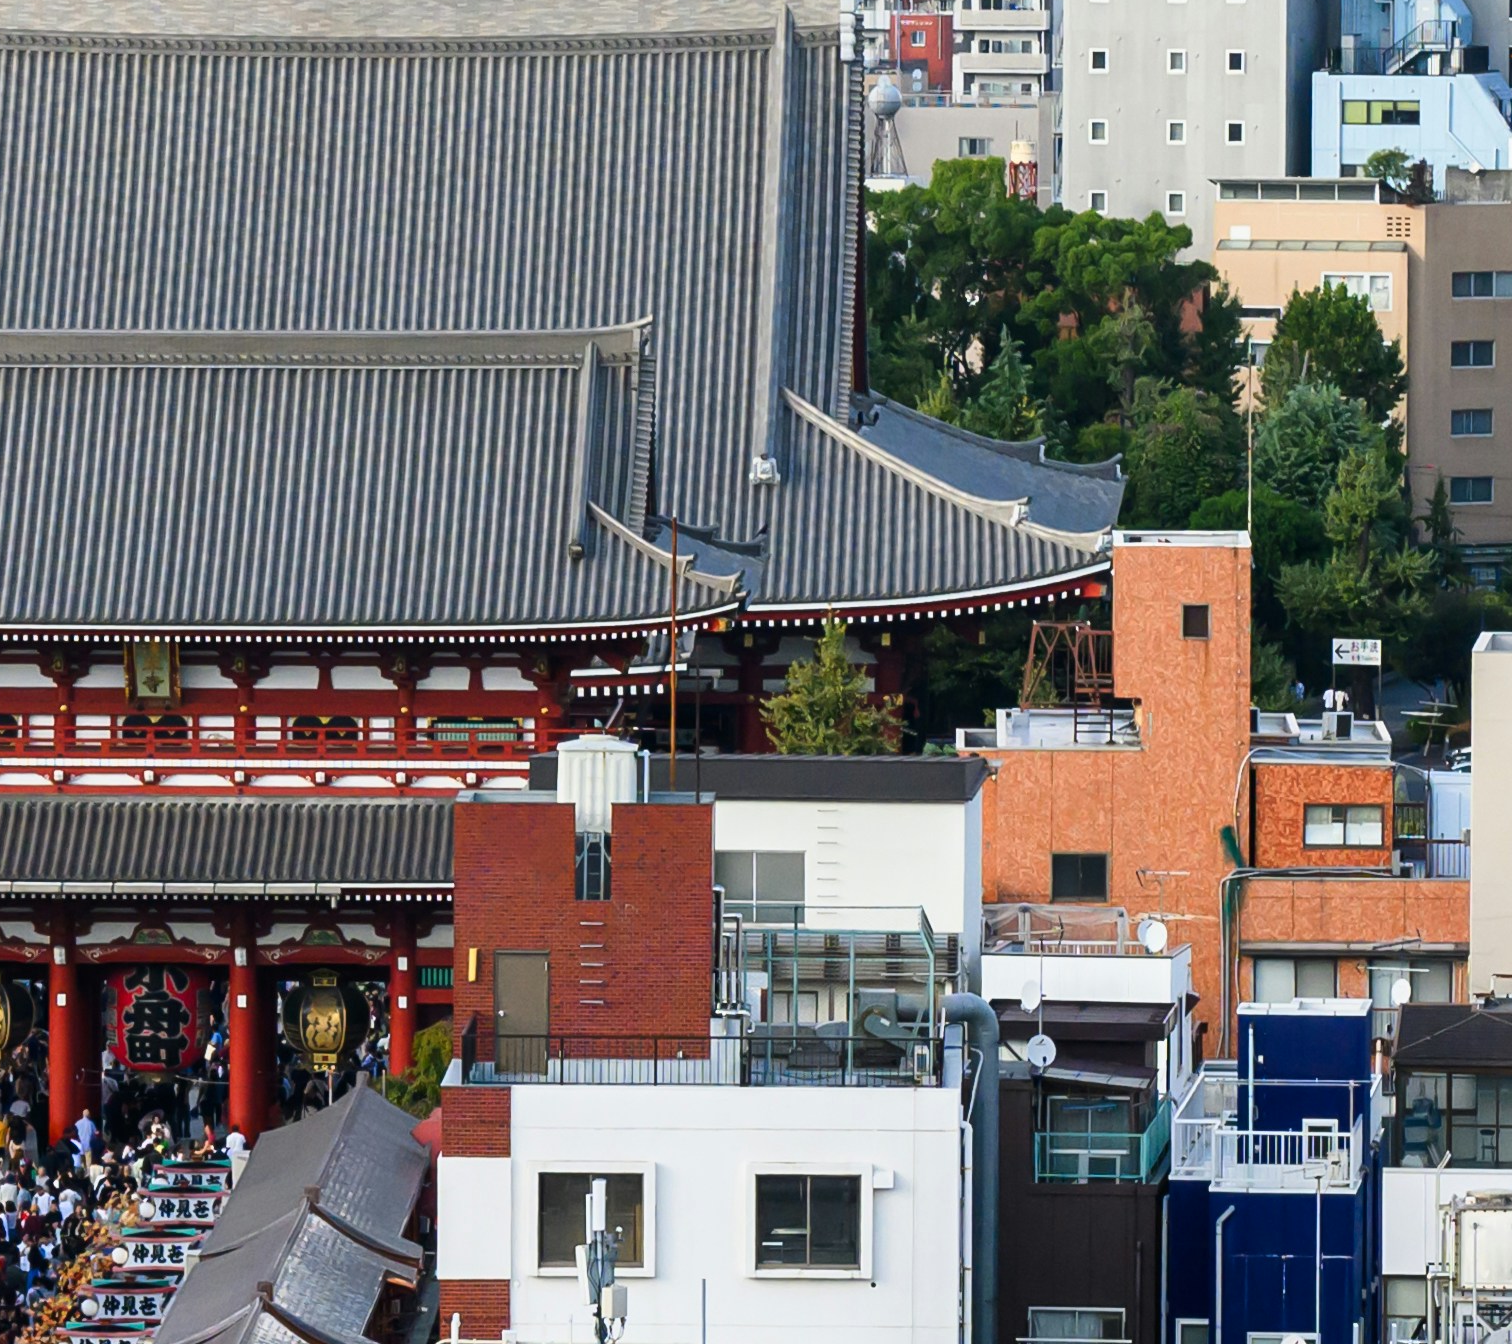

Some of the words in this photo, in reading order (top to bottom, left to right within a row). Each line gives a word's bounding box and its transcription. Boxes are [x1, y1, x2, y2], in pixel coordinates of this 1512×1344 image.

[123, 966, 192, 1069] 小舟町
[158, 1198, 210, 1219] 仲見世
[131, 1244, 184, 1265] 仲見世
[102, 1295, 157, 1316] 仲見世
